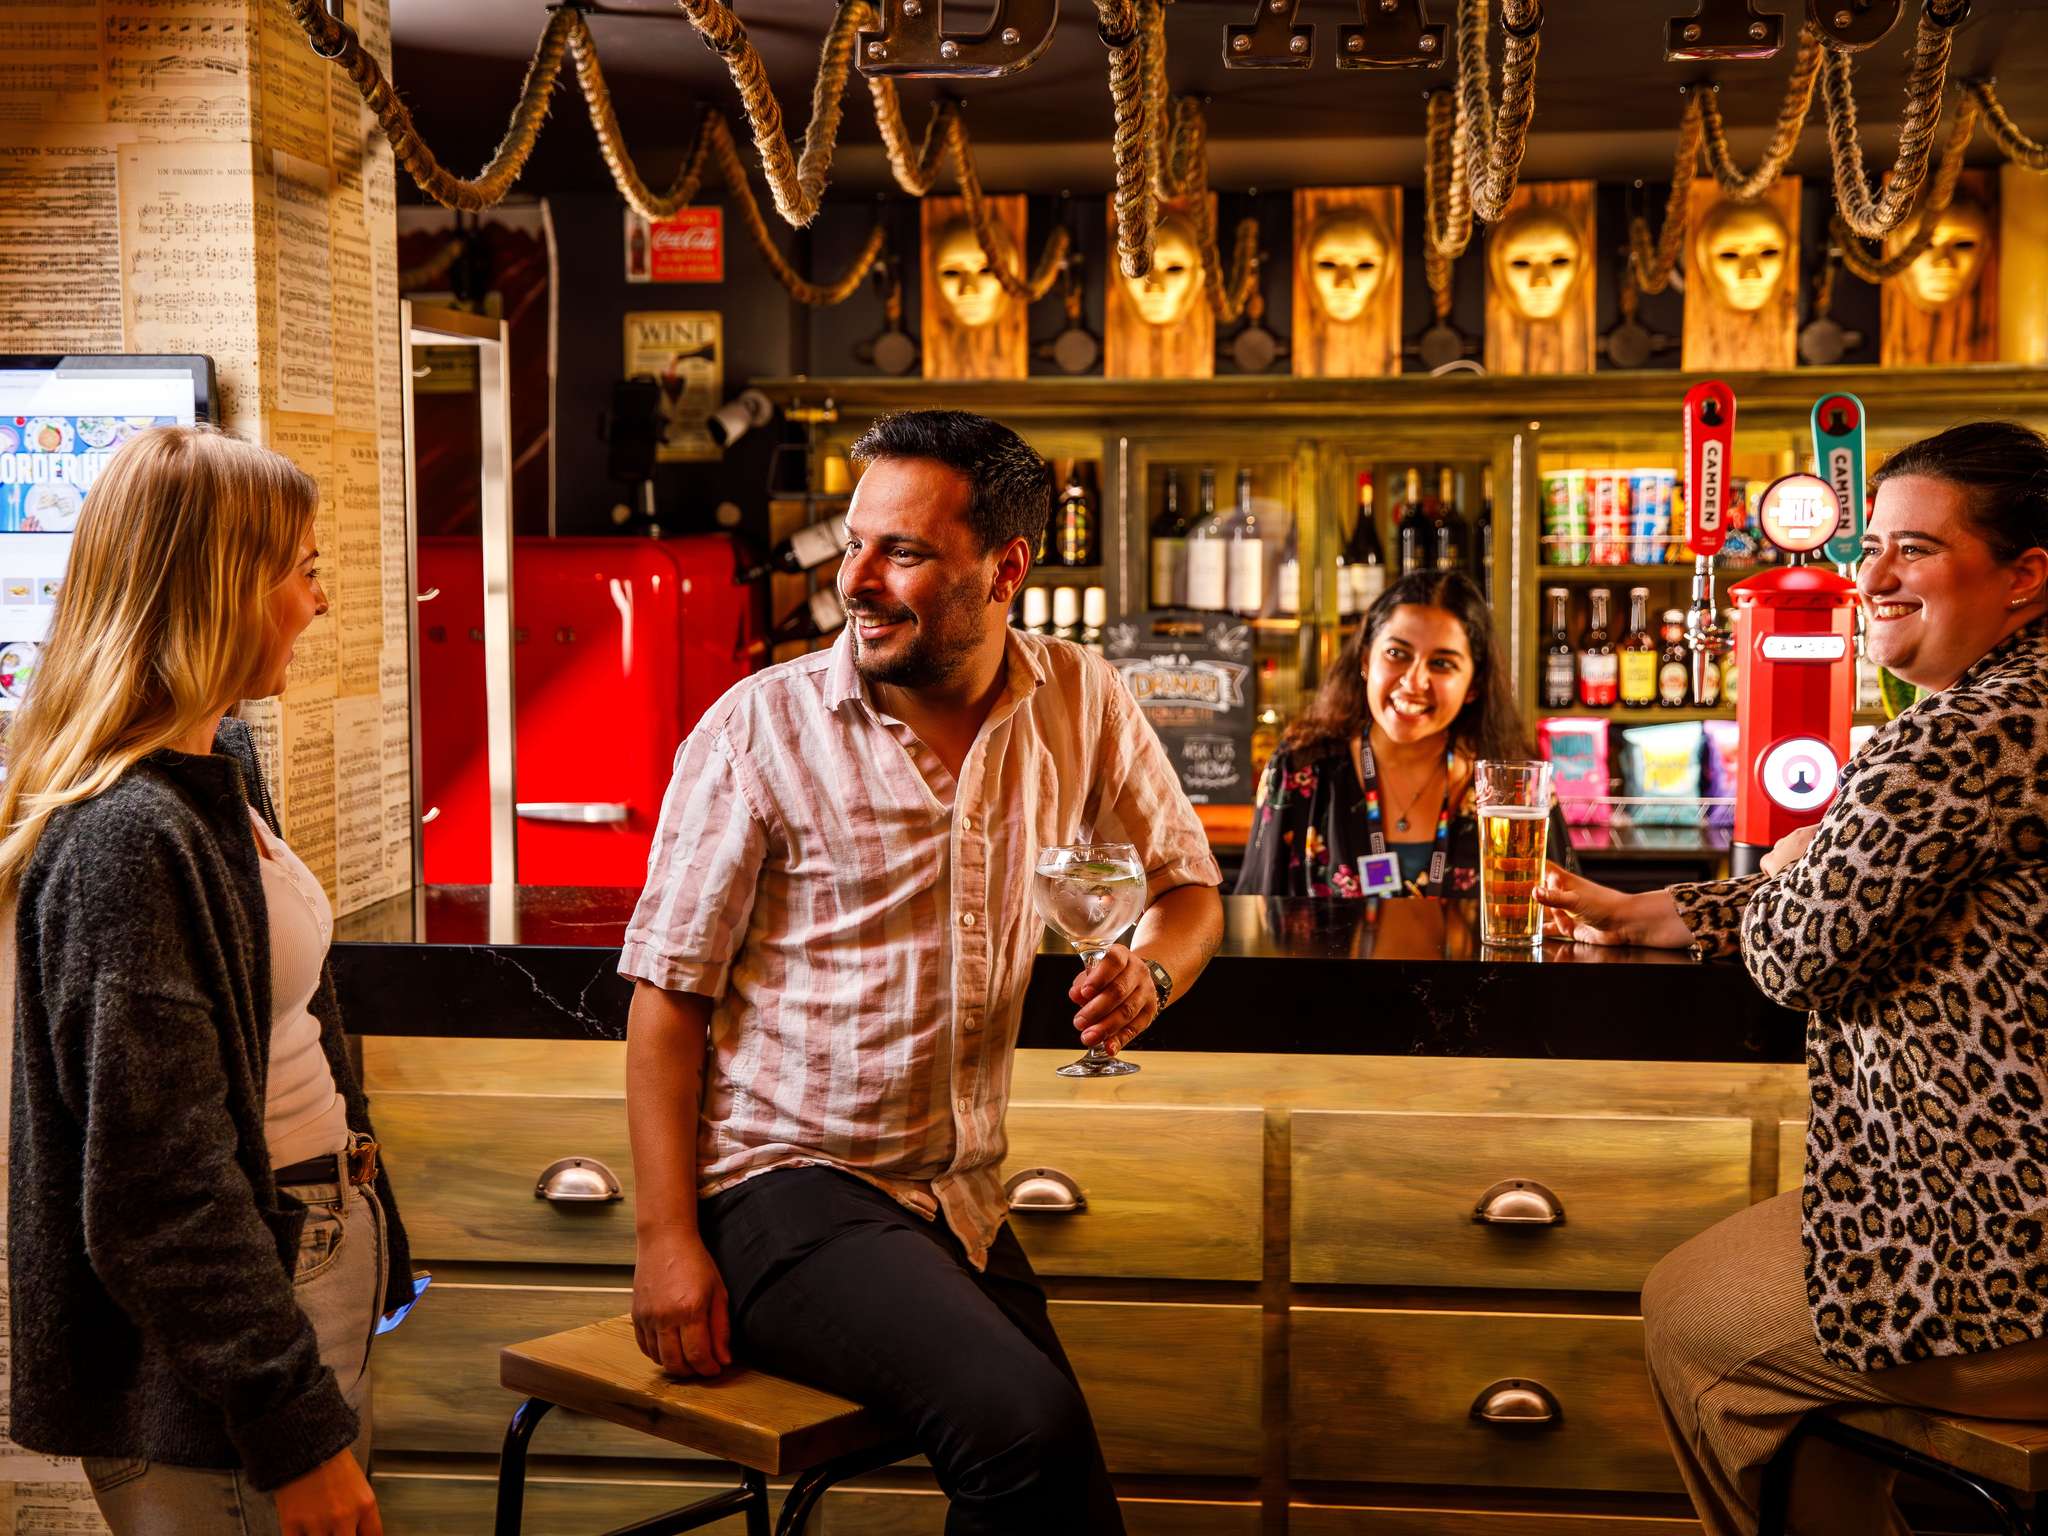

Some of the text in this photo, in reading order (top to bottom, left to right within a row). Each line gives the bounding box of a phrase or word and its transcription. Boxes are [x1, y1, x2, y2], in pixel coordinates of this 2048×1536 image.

[0, 453, 80, 485] ORDER
[1704, 447, 1718, 523] CAMDEN
[1835, 455, 1852, 529] CAMDEN
